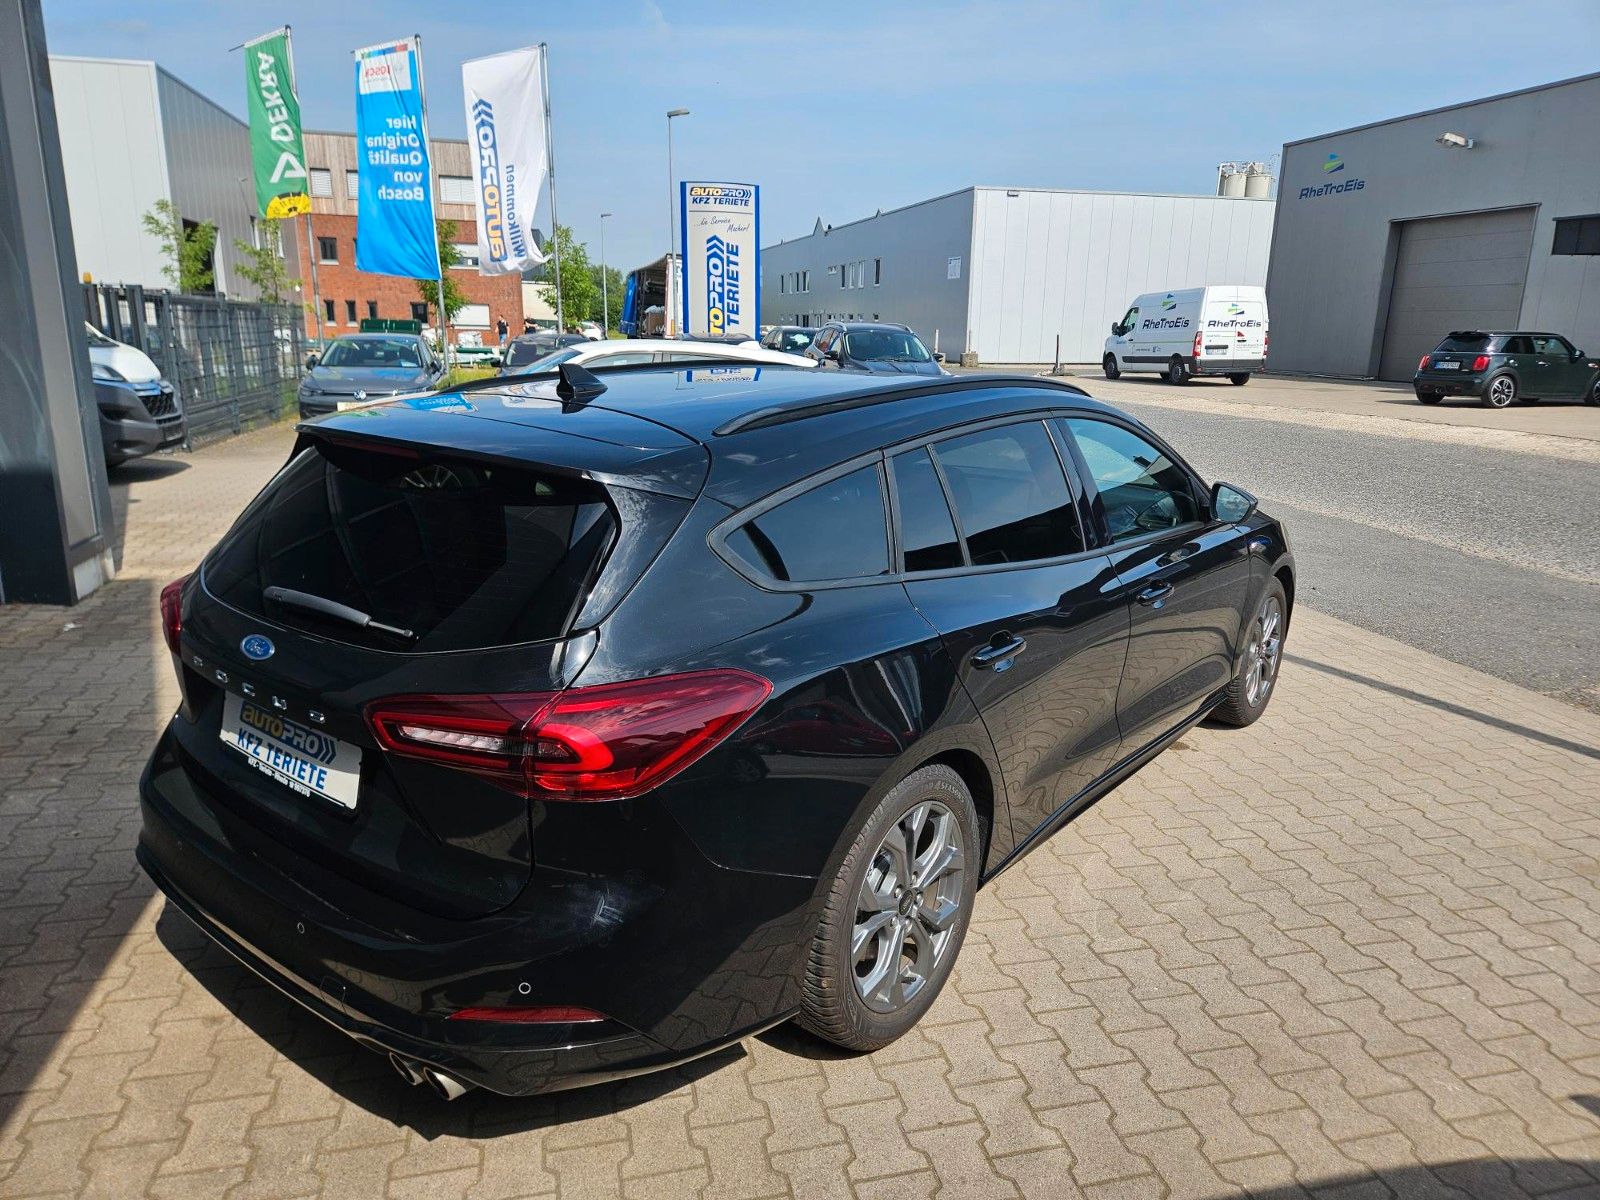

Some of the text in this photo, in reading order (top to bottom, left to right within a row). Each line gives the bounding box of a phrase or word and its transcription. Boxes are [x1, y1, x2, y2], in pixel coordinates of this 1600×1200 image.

[1299, 179, 1365, 199] RheTroEis
[692, 196, 750, 206] KFZ TERIETE
[726, 242, 740, 326] TERIETE
[1142, 317, 1190, 330] RheTroEis
[1208, 320, 1261, 328] RheTroEis
[237, 727, 263, 756] KFZ
[265, 741, 328, 790] TERIETE
